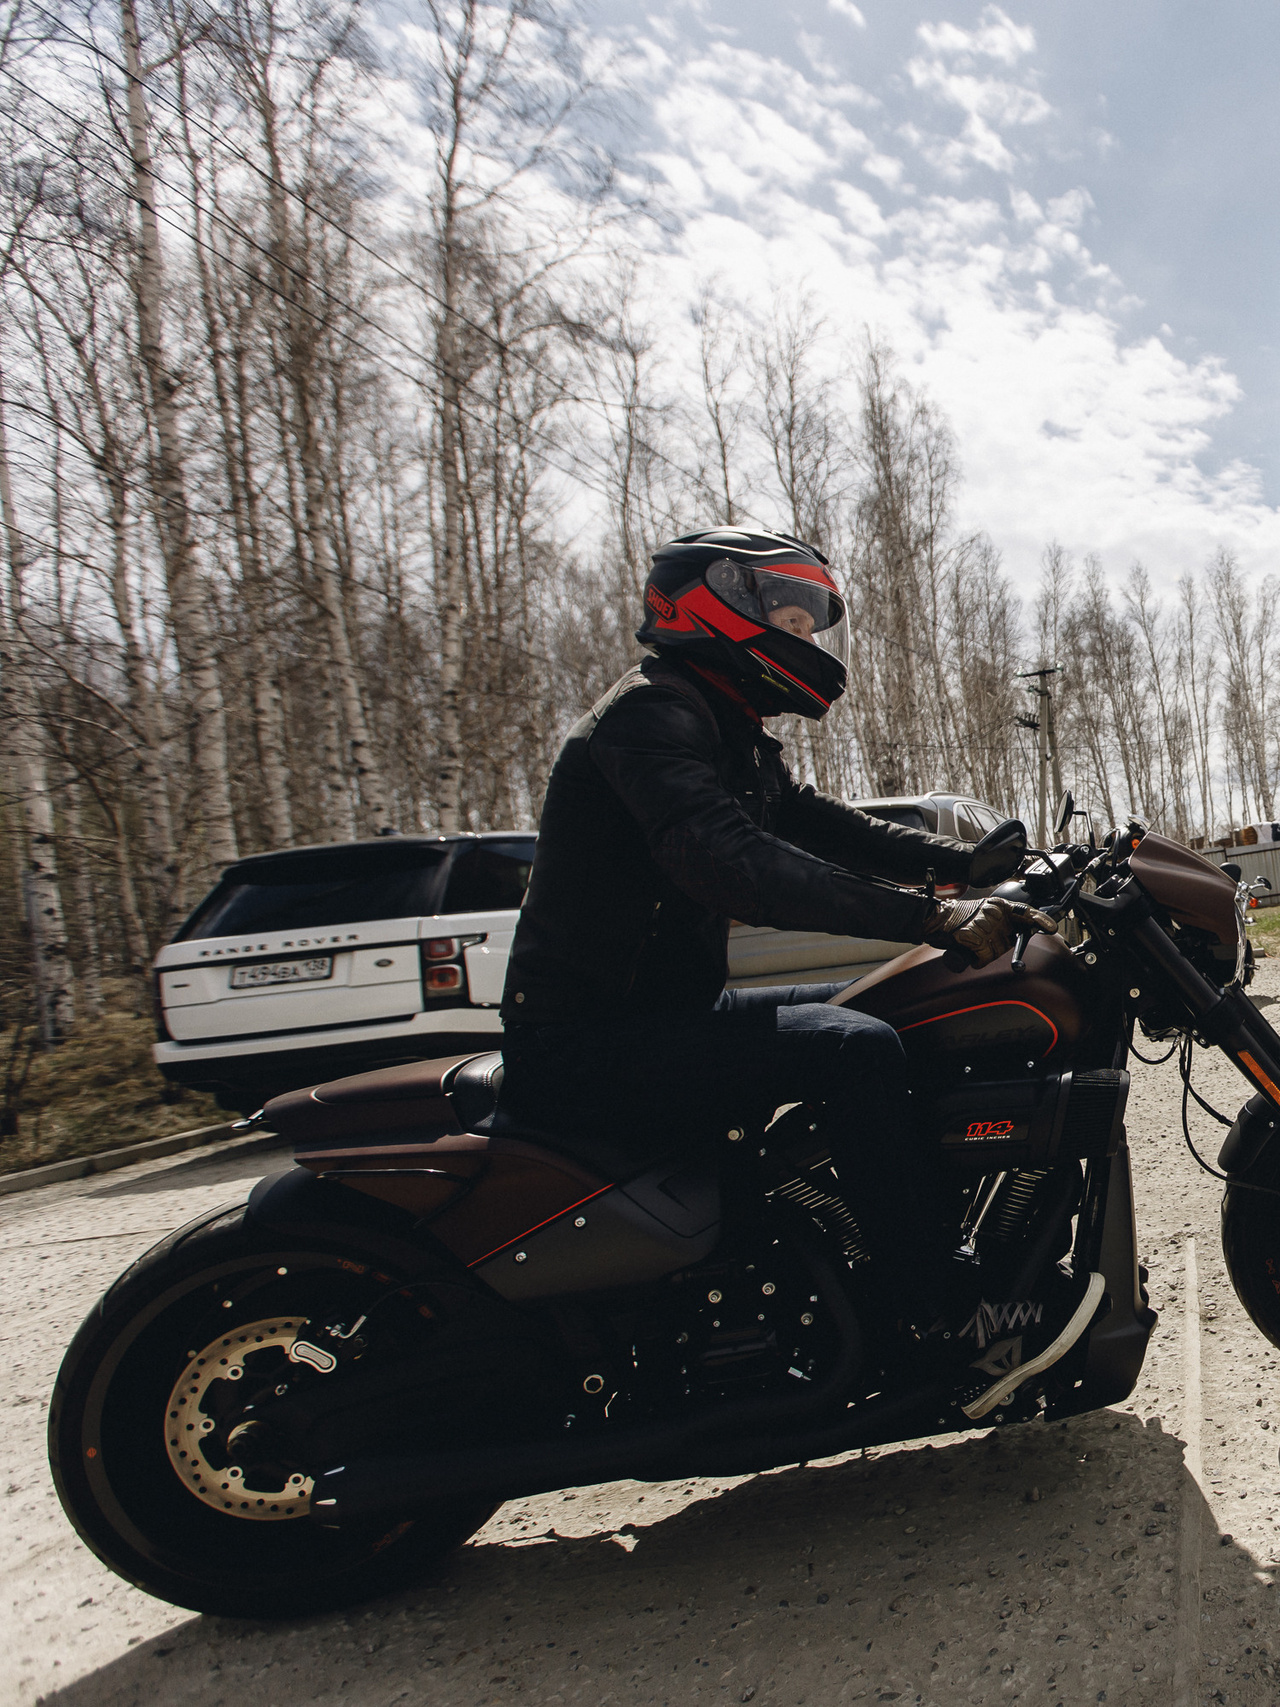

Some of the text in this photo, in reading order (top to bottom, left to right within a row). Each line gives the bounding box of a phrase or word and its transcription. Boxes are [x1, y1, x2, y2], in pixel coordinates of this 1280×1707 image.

[647, 588, 674, 619] SHOEI
[200, 934, 360, 957] RANGE ROVER
[965, 1120, 1015, 1137] 114
